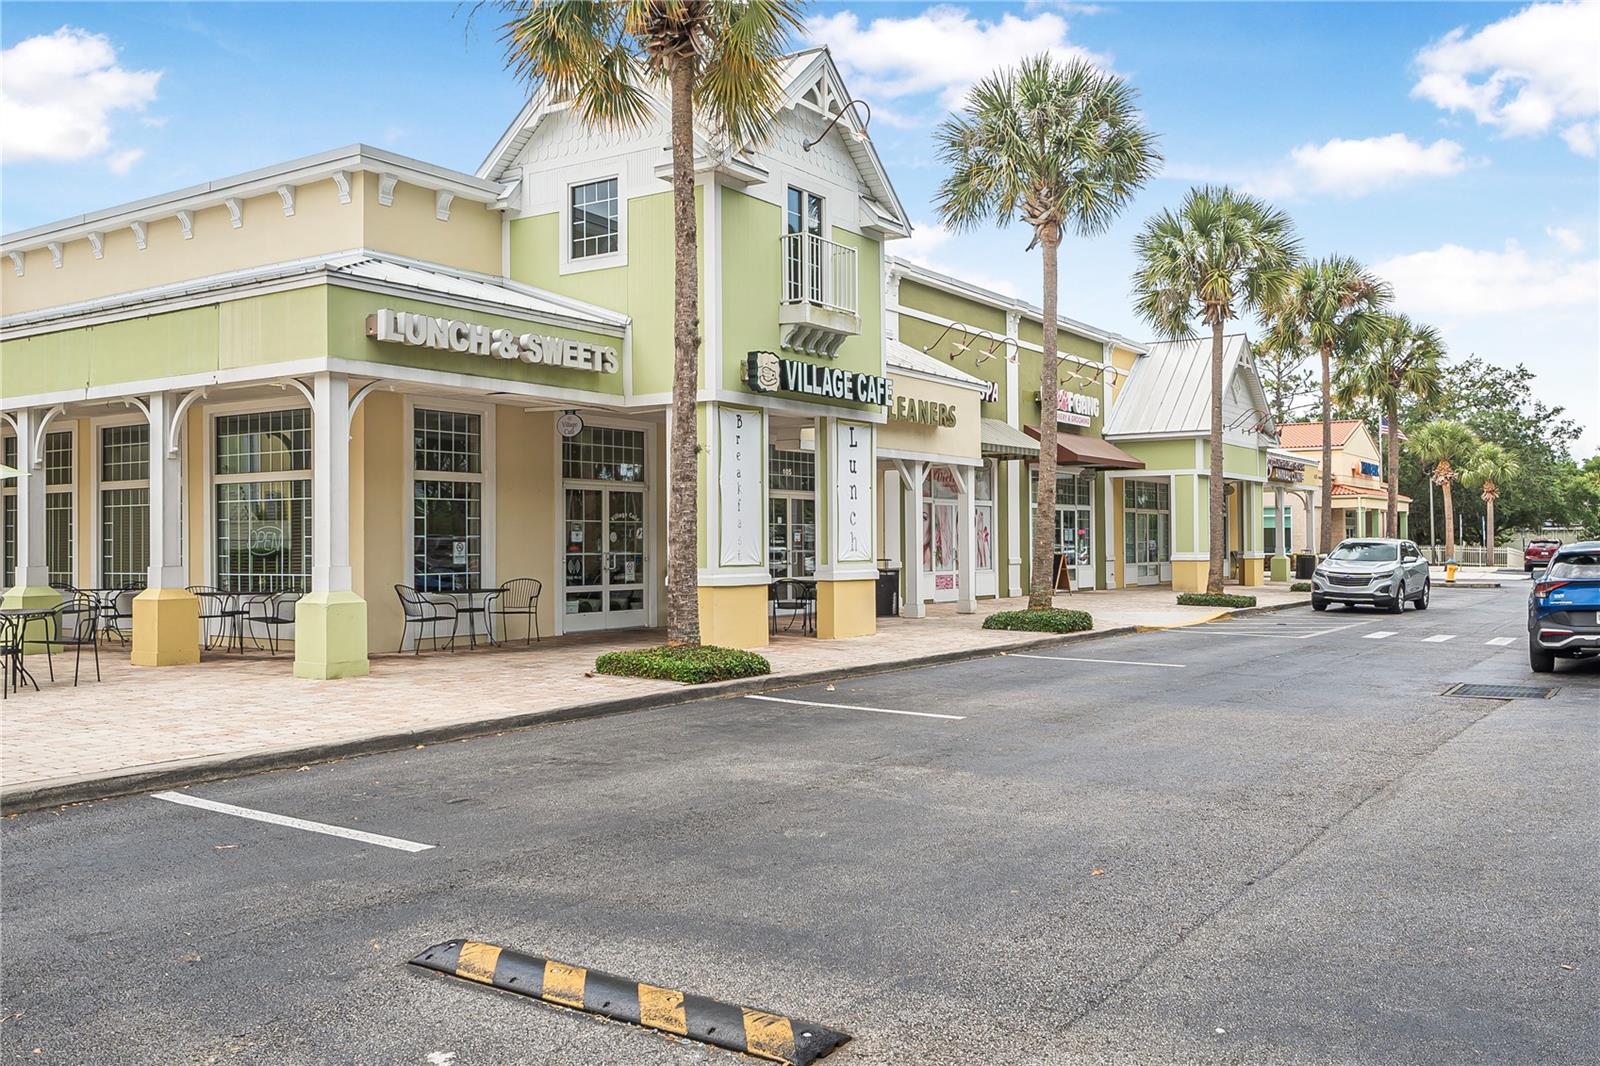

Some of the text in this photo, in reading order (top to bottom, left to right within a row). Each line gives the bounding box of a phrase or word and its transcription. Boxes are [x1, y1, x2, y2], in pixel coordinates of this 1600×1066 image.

[377, 308, 620, 374] LUNCH & SWEETS
[786, 360, 893, 407] VILLAGE CAFE
[888, 395, 957, 428] LEANERS
[1073, 393, 1099, 418] GANG
[848, 426, 859, 553] Lunch
[246, 530, 283, 552] OPEN
